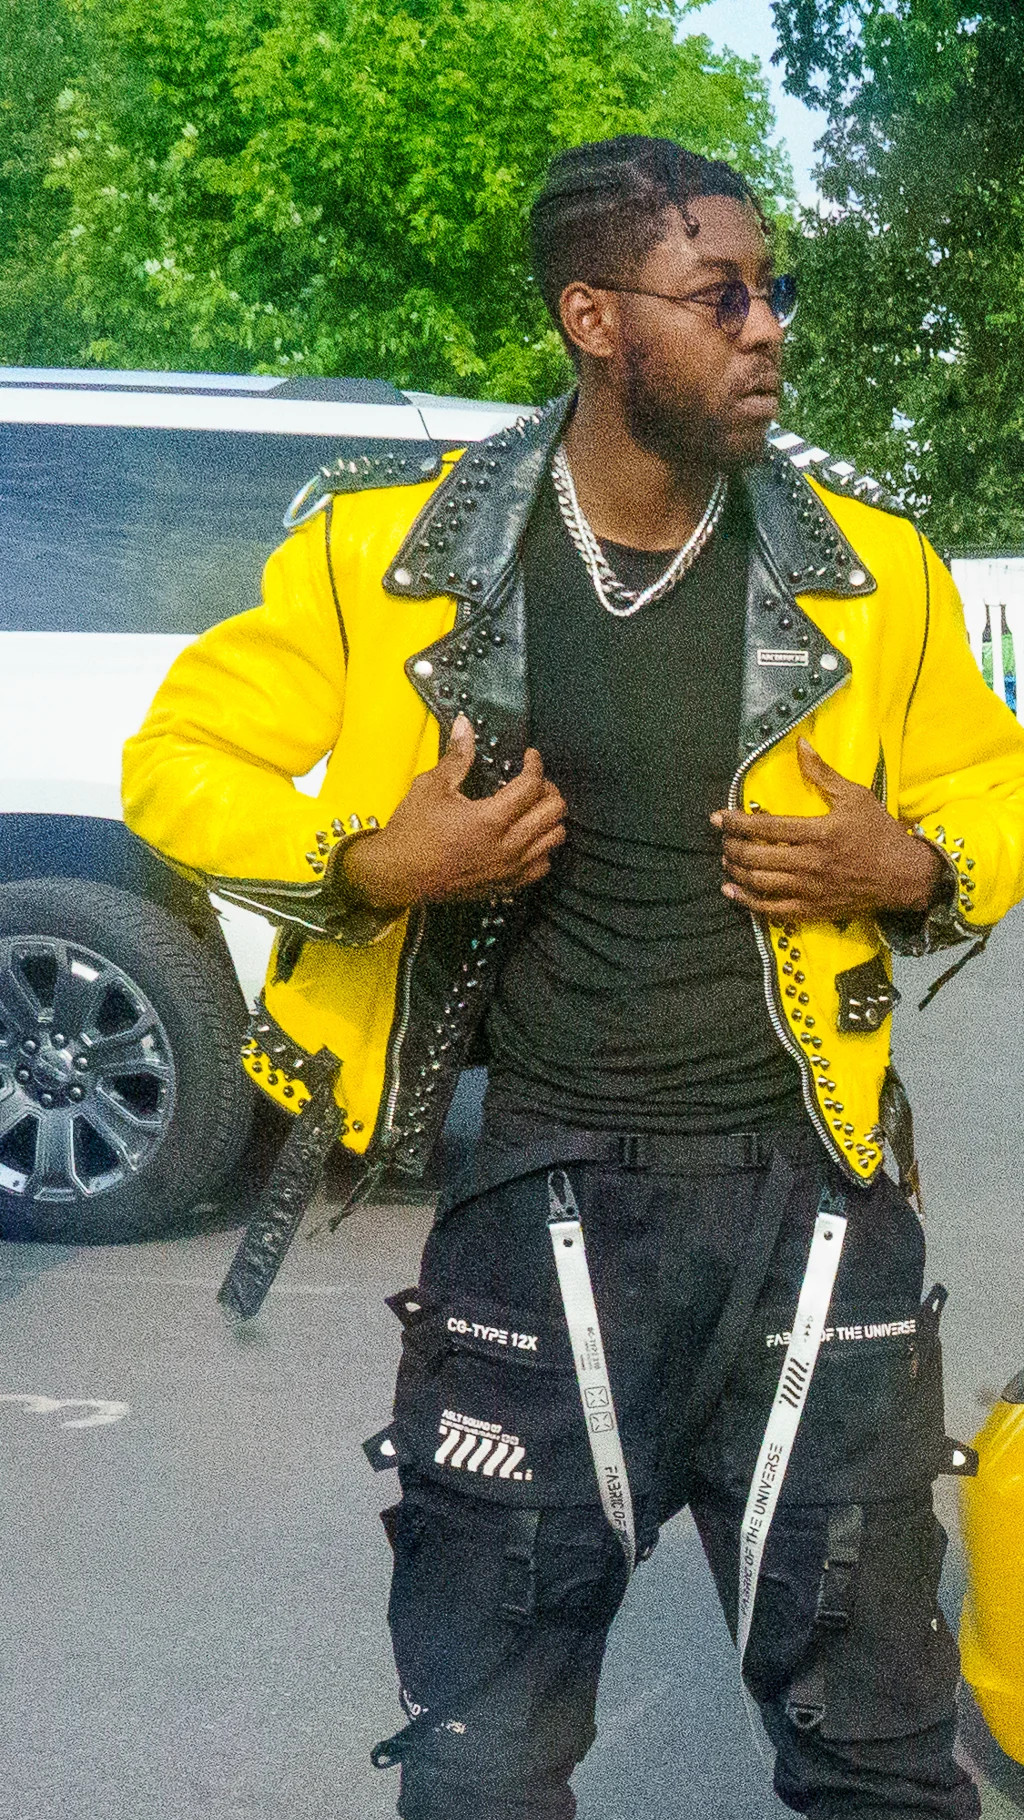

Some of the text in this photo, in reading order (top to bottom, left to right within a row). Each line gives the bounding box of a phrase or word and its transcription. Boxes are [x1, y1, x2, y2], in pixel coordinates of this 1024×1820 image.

[510, 1332, 539, 1352] 12X
[836, 1326, 863, 1340] THE
[864, 1319, 917, 1339] UNIVERSE
[604, 1466, 625, 1509] FABRIC
[755, 1442, 783, 1516] UNIVERSE
[749, 1515, 763, 1545] THE
